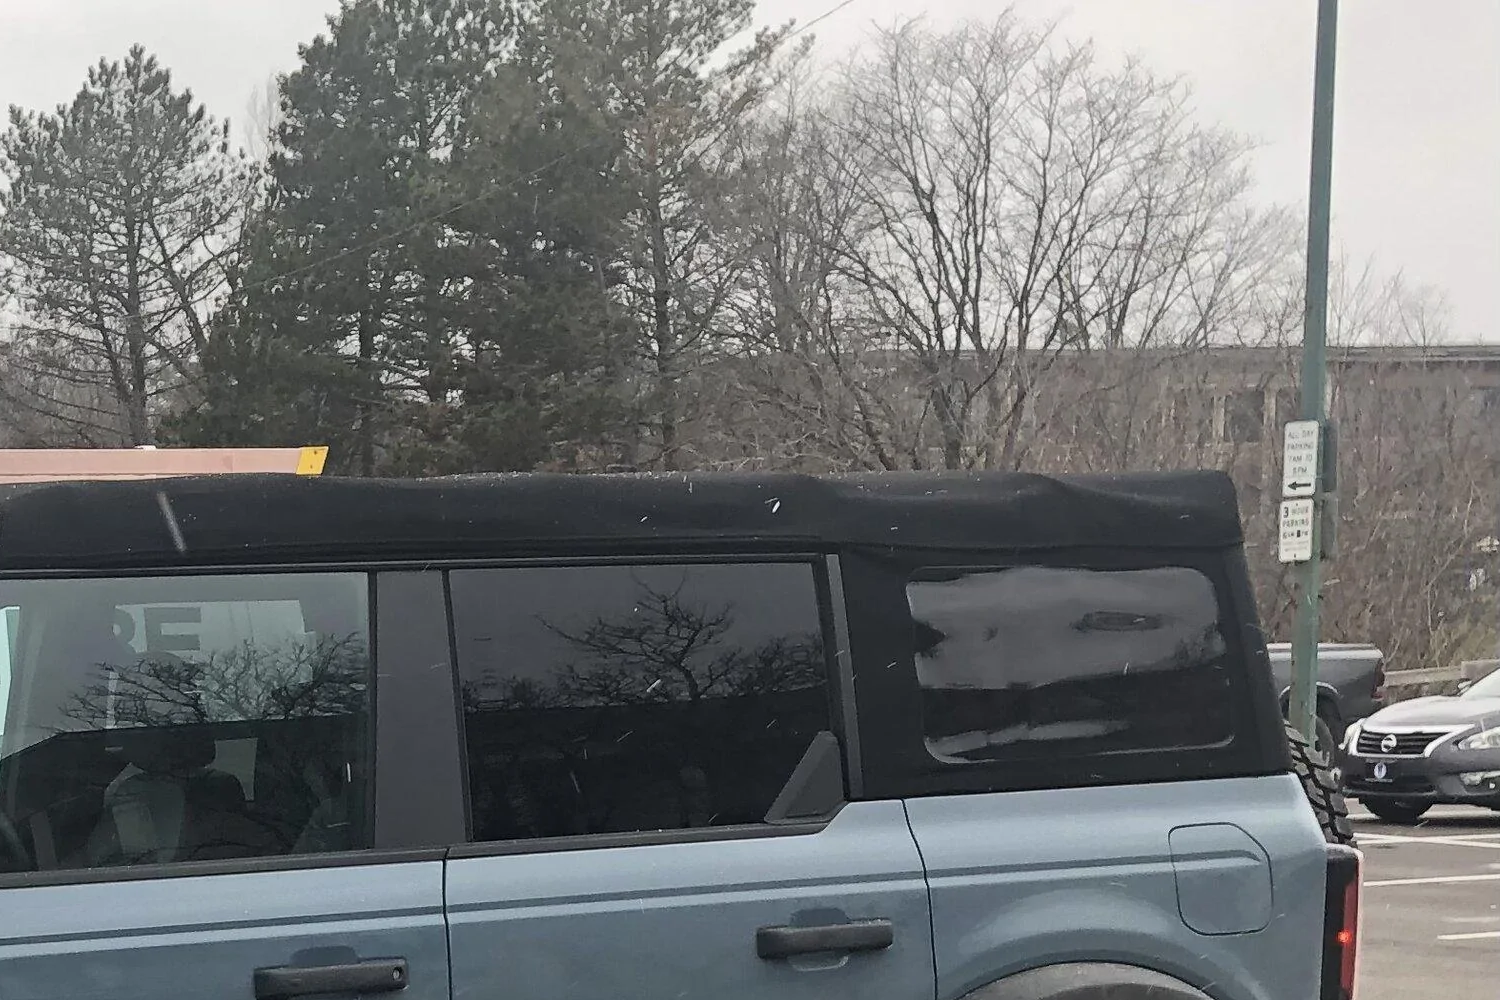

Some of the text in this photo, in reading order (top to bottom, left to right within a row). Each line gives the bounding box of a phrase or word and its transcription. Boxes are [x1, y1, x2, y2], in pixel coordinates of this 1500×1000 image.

[1287, 442, 1314, 451] PARKING
[1282, 506, 1289, 519] 3
[1282, 518, 1309, 528] PARKING
